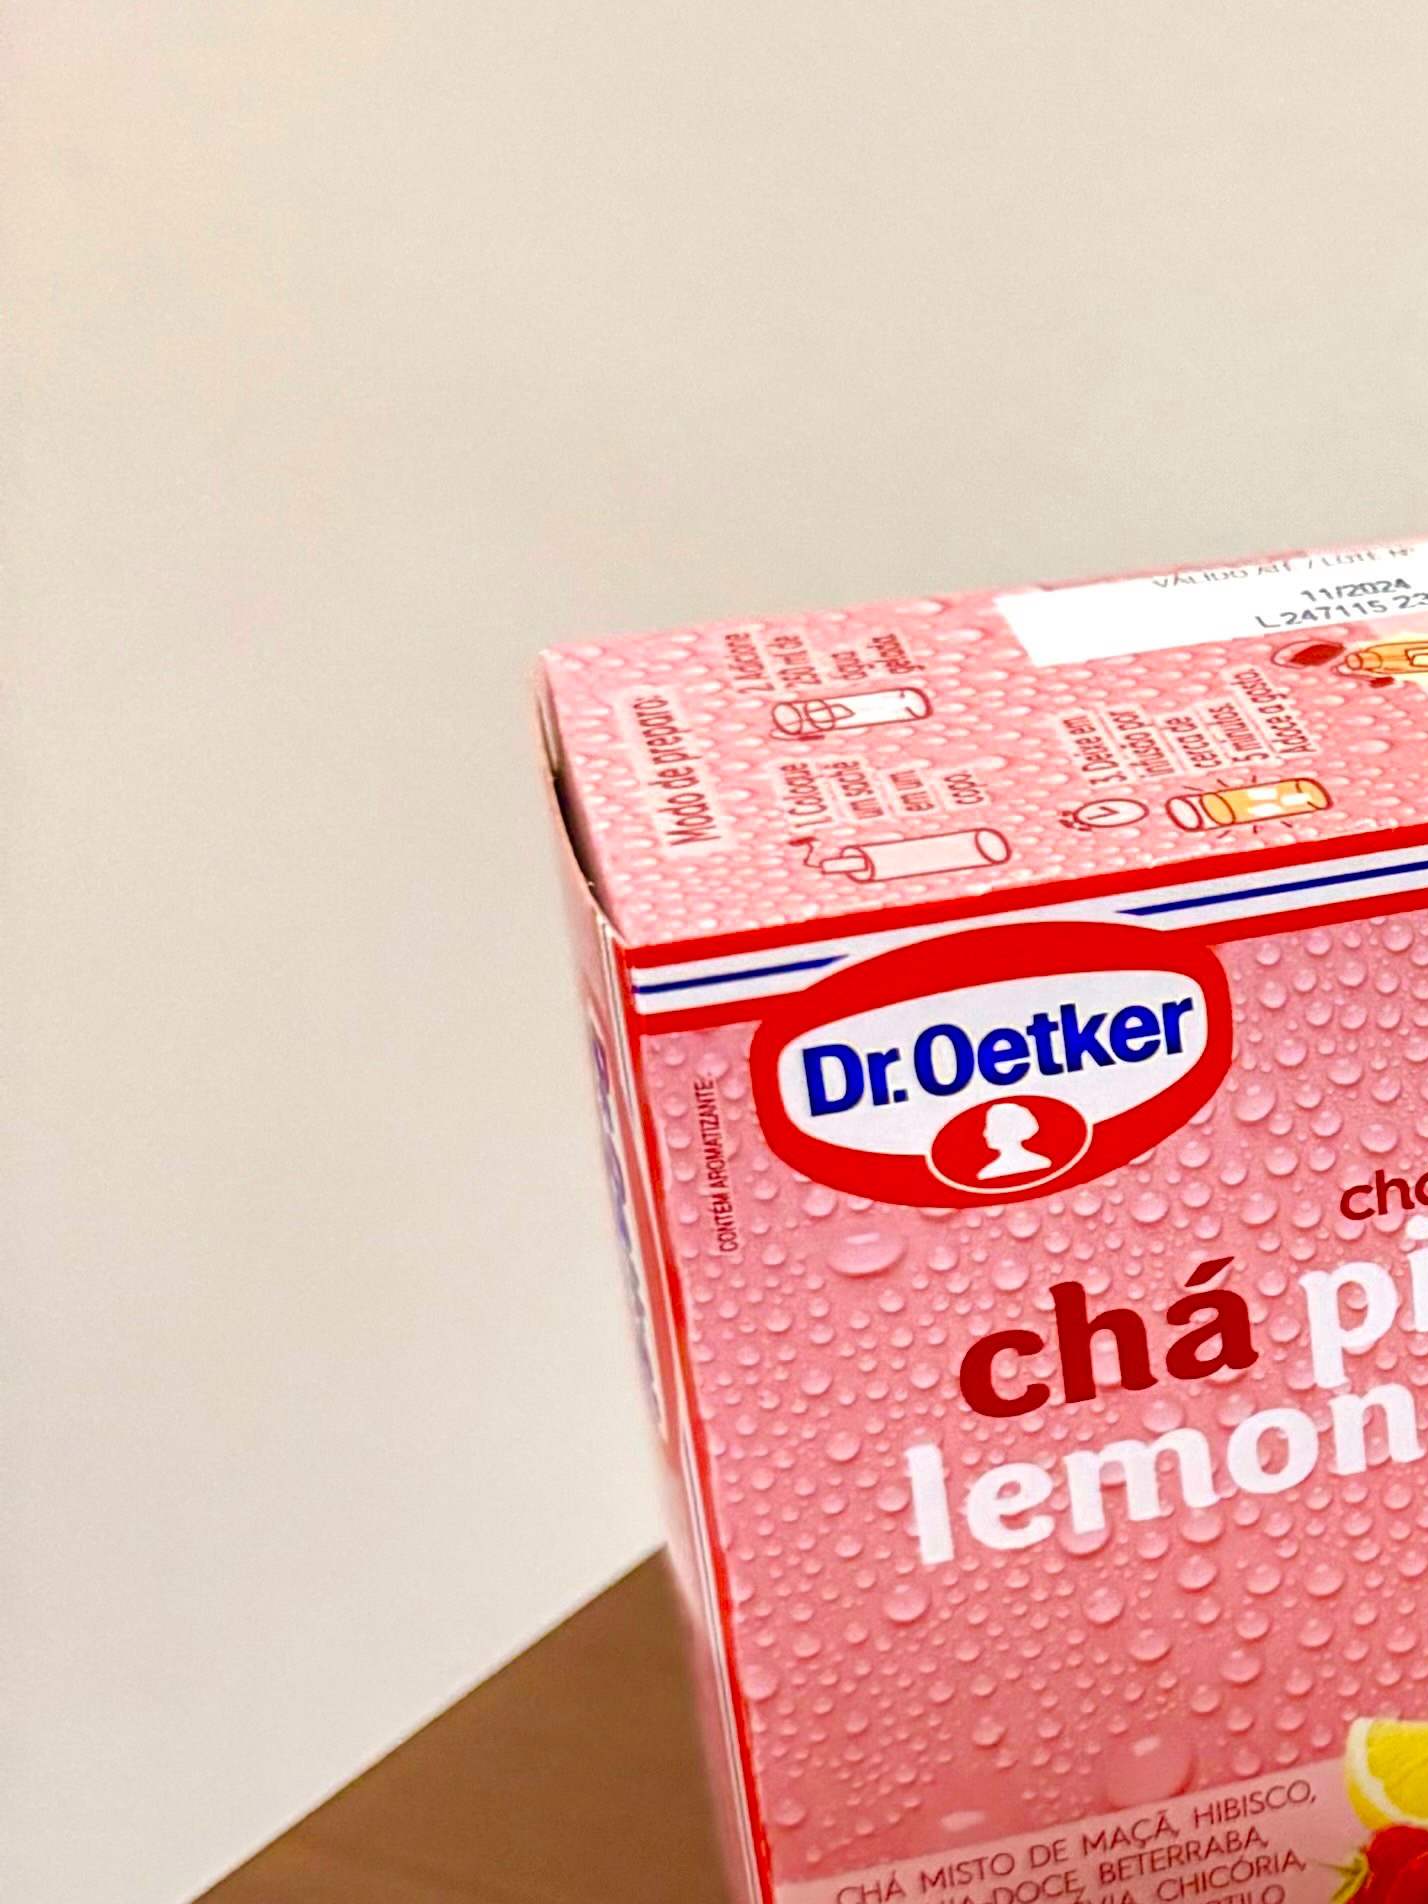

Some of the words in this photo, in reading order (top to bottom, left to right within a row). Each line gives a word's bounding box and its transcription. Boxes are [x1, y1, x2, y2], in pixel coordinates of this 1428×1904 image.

[1300, 577, 1412, 603] 11/2024
[725, 632, 773, 681] Adicione
[1062, 714, 1097, 736] em
[1108, 710, 1153, 732] por
[1159, 715, 1198, 733] de
[1258, 703, 1285, 714] a
[632, 695, 703, 765] preparo:
[1264, 715, 1318, 754] Adoce
[1073, 734, 1120, 773] Deixe
[1119, 731, 1175, 779] infusão
[1175, 733, 1222, 769] cerca
[1231, 751, 1270, 763] 5
[648, 765, 700, 790] de
[781, 762, 828, 816] Coloque
[889, 769, 924, 791] um
[657, 792, 722, 846] Modo
[849, 797, 885, 820] um
[900, 790, 935, 812] em
[708, 1192, 739, 1253] CONTÉM
[959, 1257, 1259, 1420] chá
[919, 1853, 1016, 1894] MISTO
[1030, 1839, 1068, 1870] DE
[1081, 1812, 1181, 1858] MAÇÃ,
[1192, 1779, 1319, 1829] HIBISCO,
[1099, 1825, 1270, 1884] BETERRABA,
[1156, 1848, 1307, 1904] CHICÓRIA,
